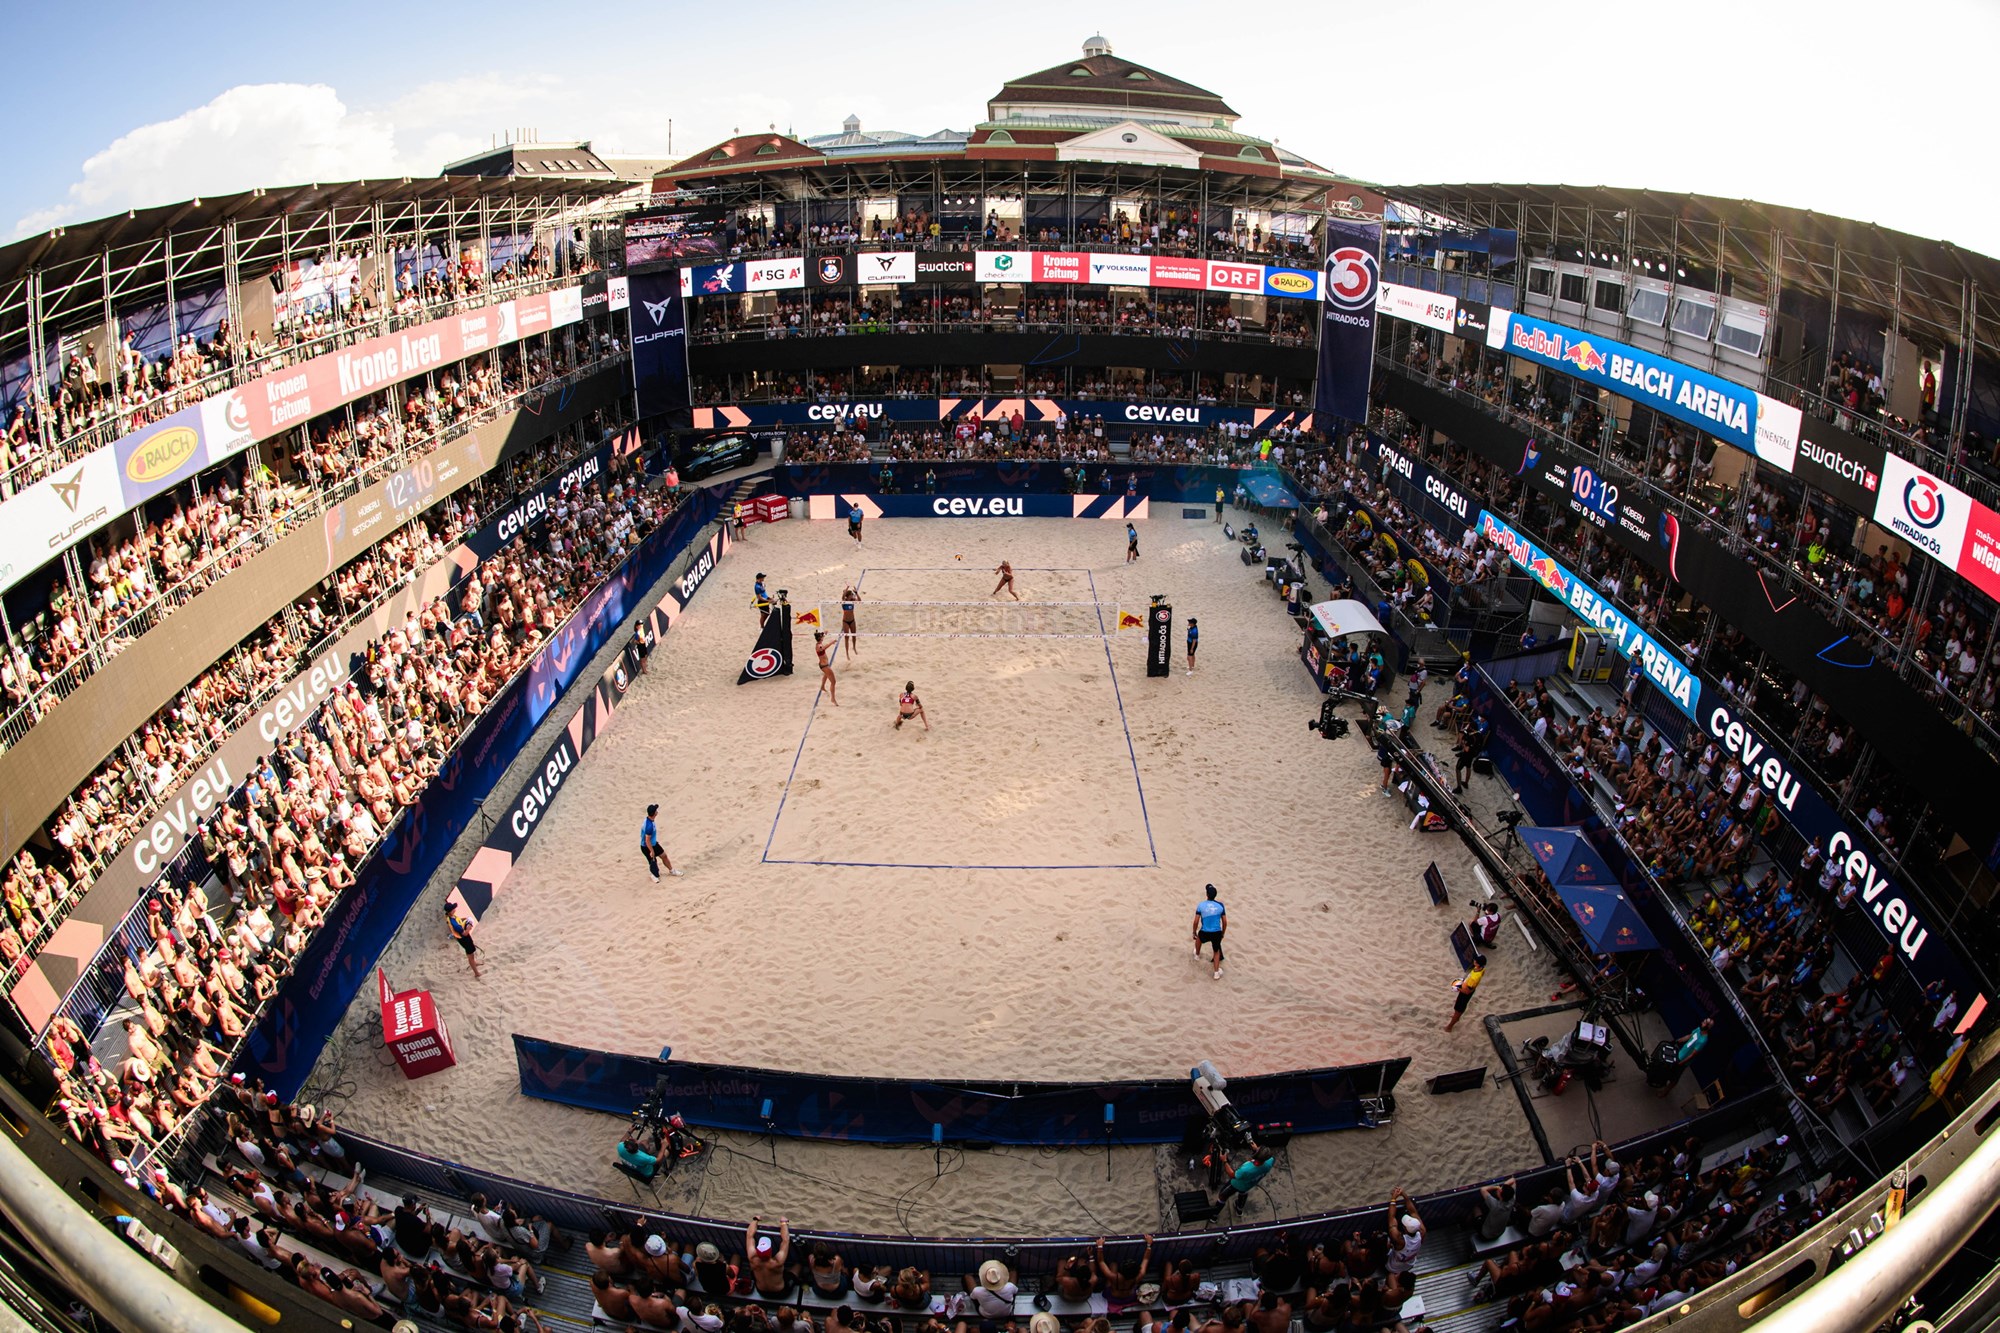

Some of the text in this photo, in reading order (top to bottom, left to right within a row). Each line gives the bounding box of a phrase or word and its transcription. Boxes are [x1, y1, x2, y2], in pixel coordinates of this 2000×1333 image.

[918, 261, 964, 272] swatch
[1043, 254, 1079, 267] Kronen
[1106, 265, 1148, 273] VOLKSBANK
[766, 269, 785, 280] 5G
[1043, 267, 1079, 281] Zeitung
[1214, 269, 1257, 285] ORF
[1280, 278, 1308, 288] RAUCH
[461, 315, 488, 333] Kronen
[1326, 310, 1370, 328] HITRADIO Ö3
[1434, 306, 1445, 319] 5G
[463, 332, 489, 352] Zeitung
[633, 327, 684, 344] CUPRA
[337, 333, 442, 396] Krone Area
[266, 373, 308, 403] Kronen
[1610, 354, 1674, 400] BEACH
[1676, 380, 1748, 434] ARENA
[270, 396, 311, 426] Zeitung
[808, 403, 883, 420] cev.eu
[1124, 404, 1200, 423] cev.eu
[145, 434, 191, 470] RAUCH
[1800, 439, 1866, 486] swatch
[1554, 465, 1567, 477] STAM
[770, 504, 787, 513] Kronen
[933, 497, 1024, 515] cev.eu
[1425, 475, 1468, 518] cev.eu
[352, 512, 382, 536] BETSCHART
[395, 513, 405, 524] SUI
[498, 492, 548, 540] cev.eu
[771, 511, 788, 520] Zeitung
[1570, 500, 1581, 512] NED
[1596, 516, 1606, 528] SUI
[1622, 505, 1646, 524] HÜBERLI
[48, 506, 108, 550] CUPRA
[1619, 516, 1651, 541] BETSCHART
[1892, 517, 1941, 555] HITRADIO Ö3
[1975, 528, 1995, 546] mehr
[681, 551, 713, 599] cev.eu
[1158, 625, 1167, 664] HITRADIO Ö3
[1570, 583, 1629, 647] BEACH
[1627, 633, 1692, 708] ARENA
[259, 651, 344, 743] cev.eu
[1710, 707, 1802, 811] cev.eu
[511, 744, 572, 839] cev.eu
[134, 757, 233, 874] cev.eu
[1829, 831, 1929, 961] cev.eu
[309, 888, 368, 1000] EuroBeachVolley
[395, 1000, 409, 1036] Kronen
[410, 996, 423, 1031] Zeitung
[397, 1035, 435, 1054] Kronen
[403, 1046, 441, 1064] Zeitung
